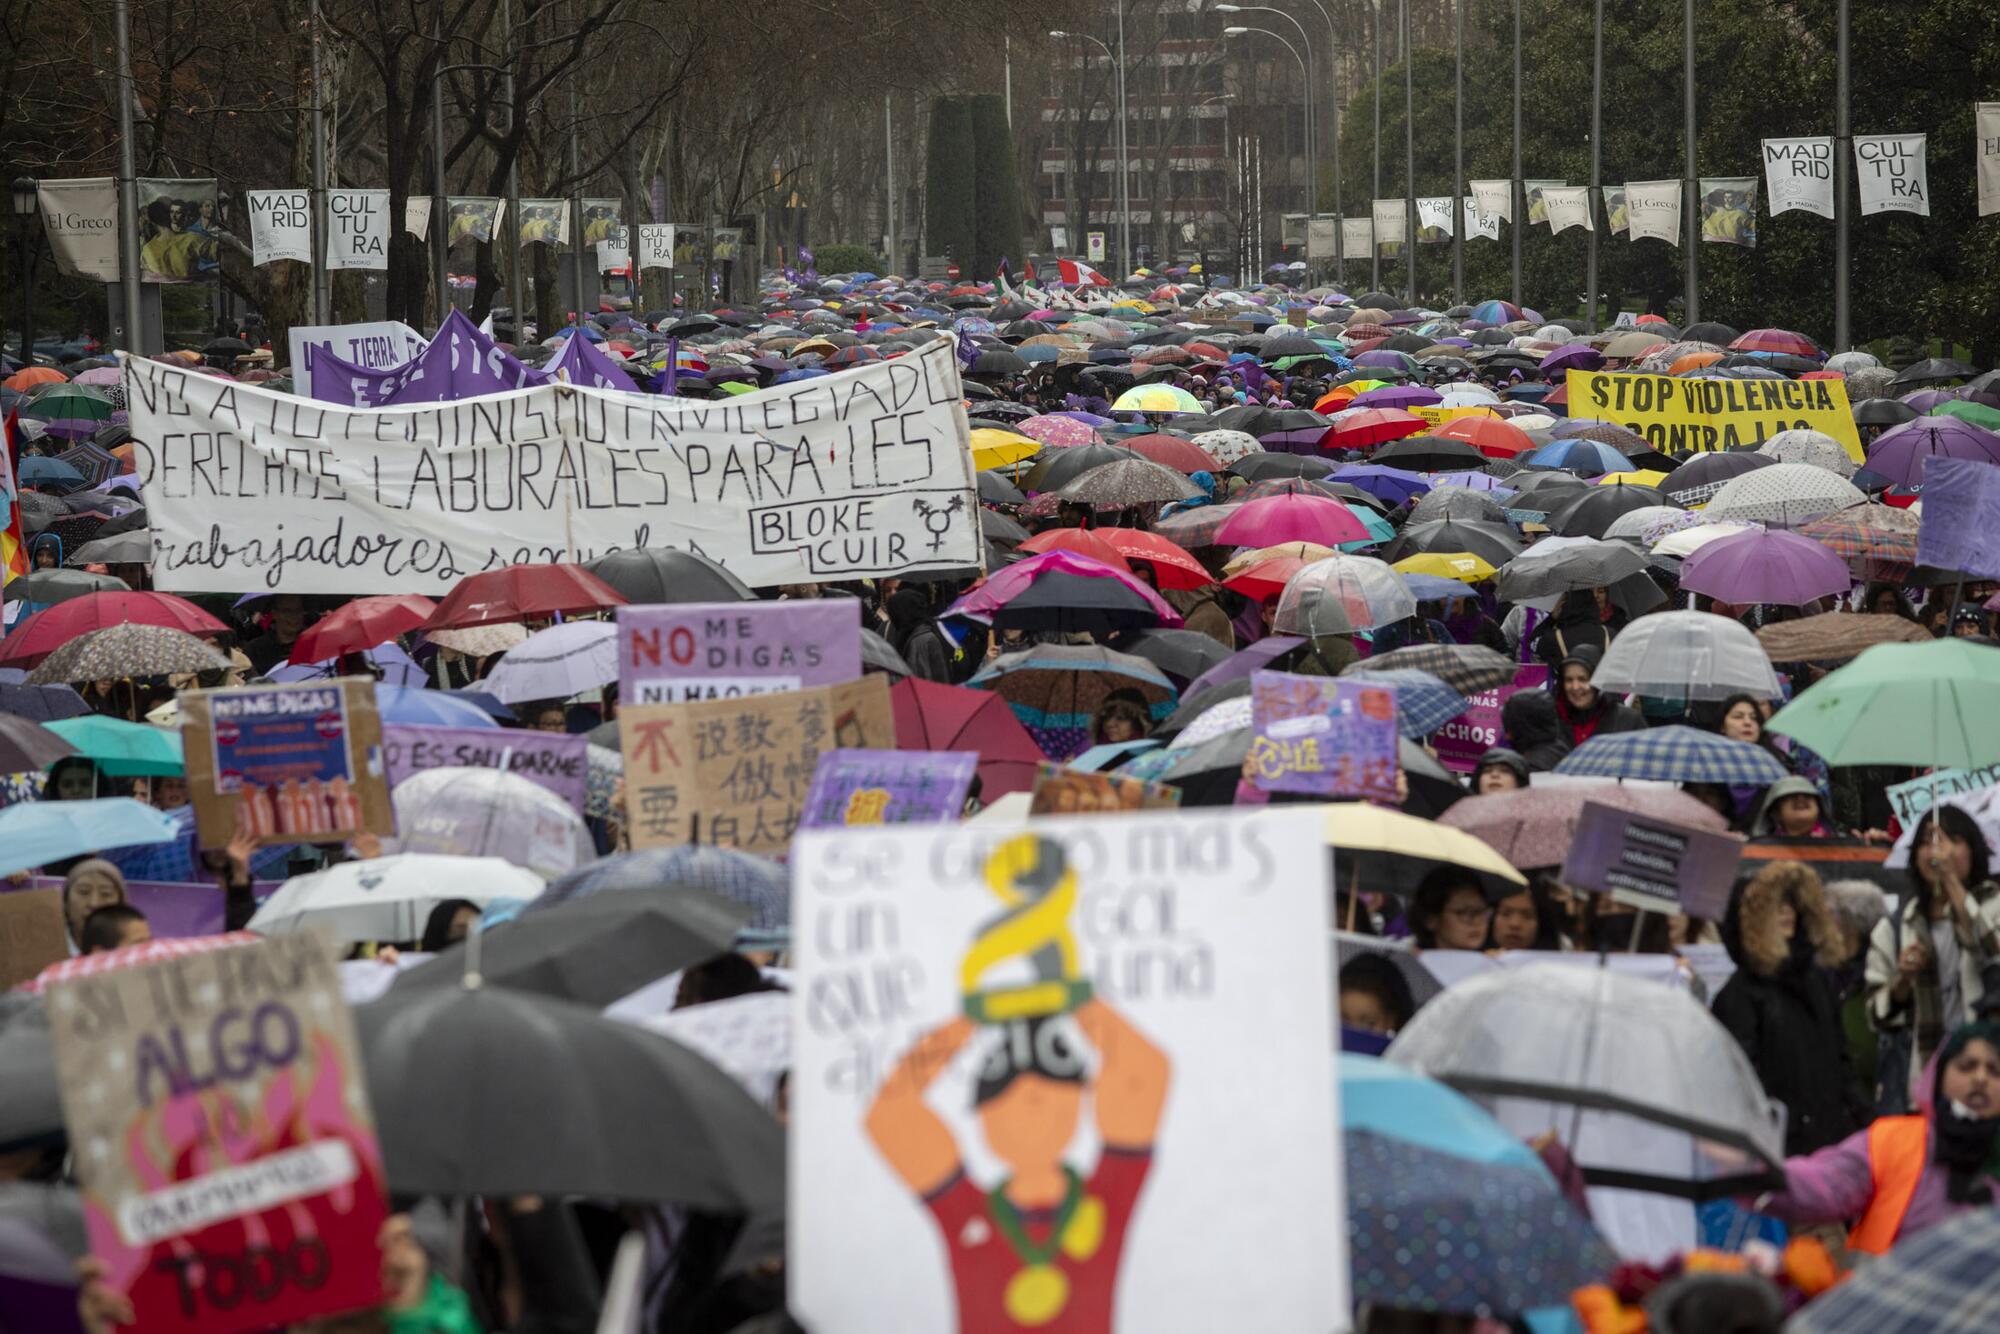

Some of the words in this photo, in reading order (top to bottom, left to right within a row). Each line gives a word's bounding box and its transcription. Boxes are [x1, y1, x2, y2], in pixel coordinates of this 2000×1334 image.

[1766, 144, 1830, 163] MAD
[1859, 142, 1914, 160] CUL
[1792, 160, 1830, 180] RID
[1869, 159, 1906, 178] TU
[1891, 178, 1924, 201] RA
[250, 195, 307, 213] MAD
[331, 195, 377, 214] CUL
[1631, 198, 1642, 210] El
[49, 213, 62, 230] El
[66, 213, 113, 230] Greco
[272, 211, 307, 228] RID
[337, 215, 368, 234] TU
[1479, 218, 1496, 232] RA
[640, 228, 666, 238] CUL
[645, 237, 662, 248] TU
[352, 235, 384, 256] RA
[607, 240, 628, 250] RID
[653, 248, 671, 260] RA
[1591, 376, 1673, 413] STOP
[1681, 379, 1836, 414] VIOLENCIA
[209, 385, 242, 429] A
[374, 440, 668, 513] LABORALES
[686, 436, 825, 504] PARA
[849, 410, 932, 489] LES
[761, 501, 874, 545] BLOKE
[818, 533, 909, 566] CUIR
[630, 626, 696, 668] NO
[705, 616, 754, 638] ME
[708, 644, 823, 669] DIGAS
[643, 686, 672, 704] NI
[411, 742, 446, 768] ES
[135, 1001, 304, 1110] ALGO
[154, 1234, 331, 1319] TODO
